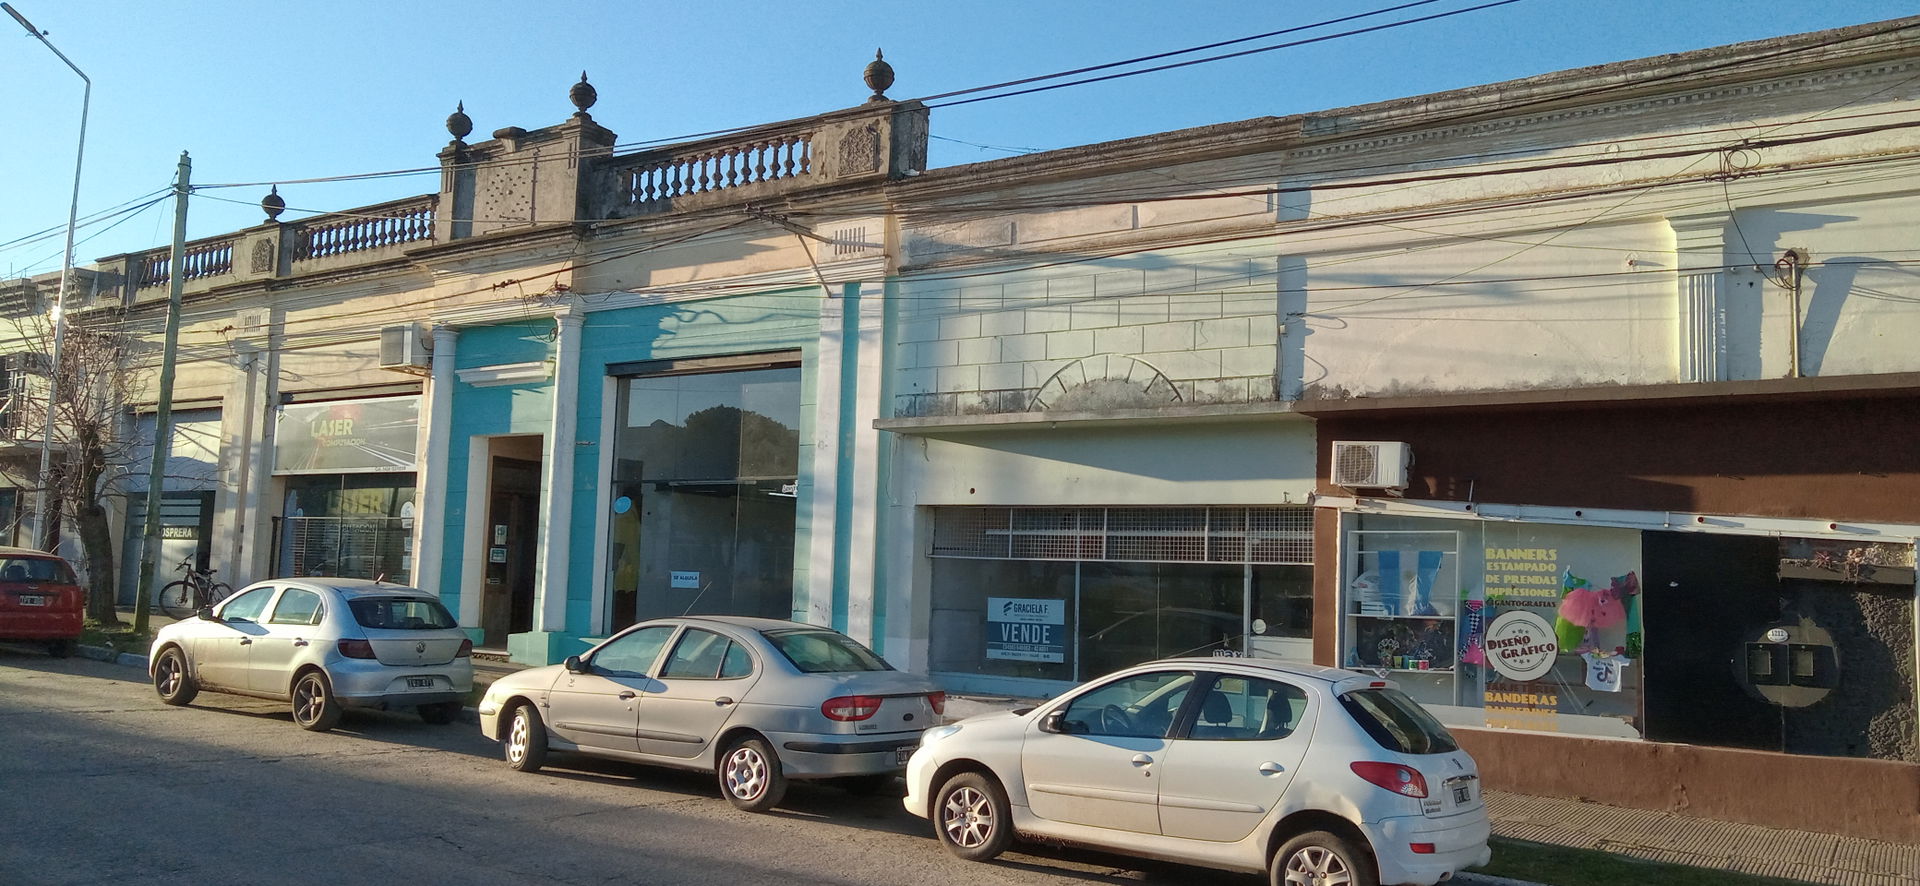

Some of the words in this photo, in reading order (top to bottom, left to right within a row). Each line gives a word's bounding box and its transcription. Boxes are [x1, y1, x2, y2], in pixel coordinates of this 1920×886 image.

[311, 419, 353, 437] LASER
[327, 488, 385, 515] LASER
[1486, 548, 1557, 560] BANNERS
[1486, 562, 1557, 572] ESTAMPADO
[1485, 574, 1500, 584] DE
[1504, 574, 1557, 585] PRENDAS
[1485, 587, 1557, 598] IMPRESIONES
[1013, 603, 1043, 614] GRACIELA
[1001, 623, 1051, 644] VENDE
[1487, 635, 1531, 650] DISEÑO
[1485, 692, 1557, 705] BANDERAS
